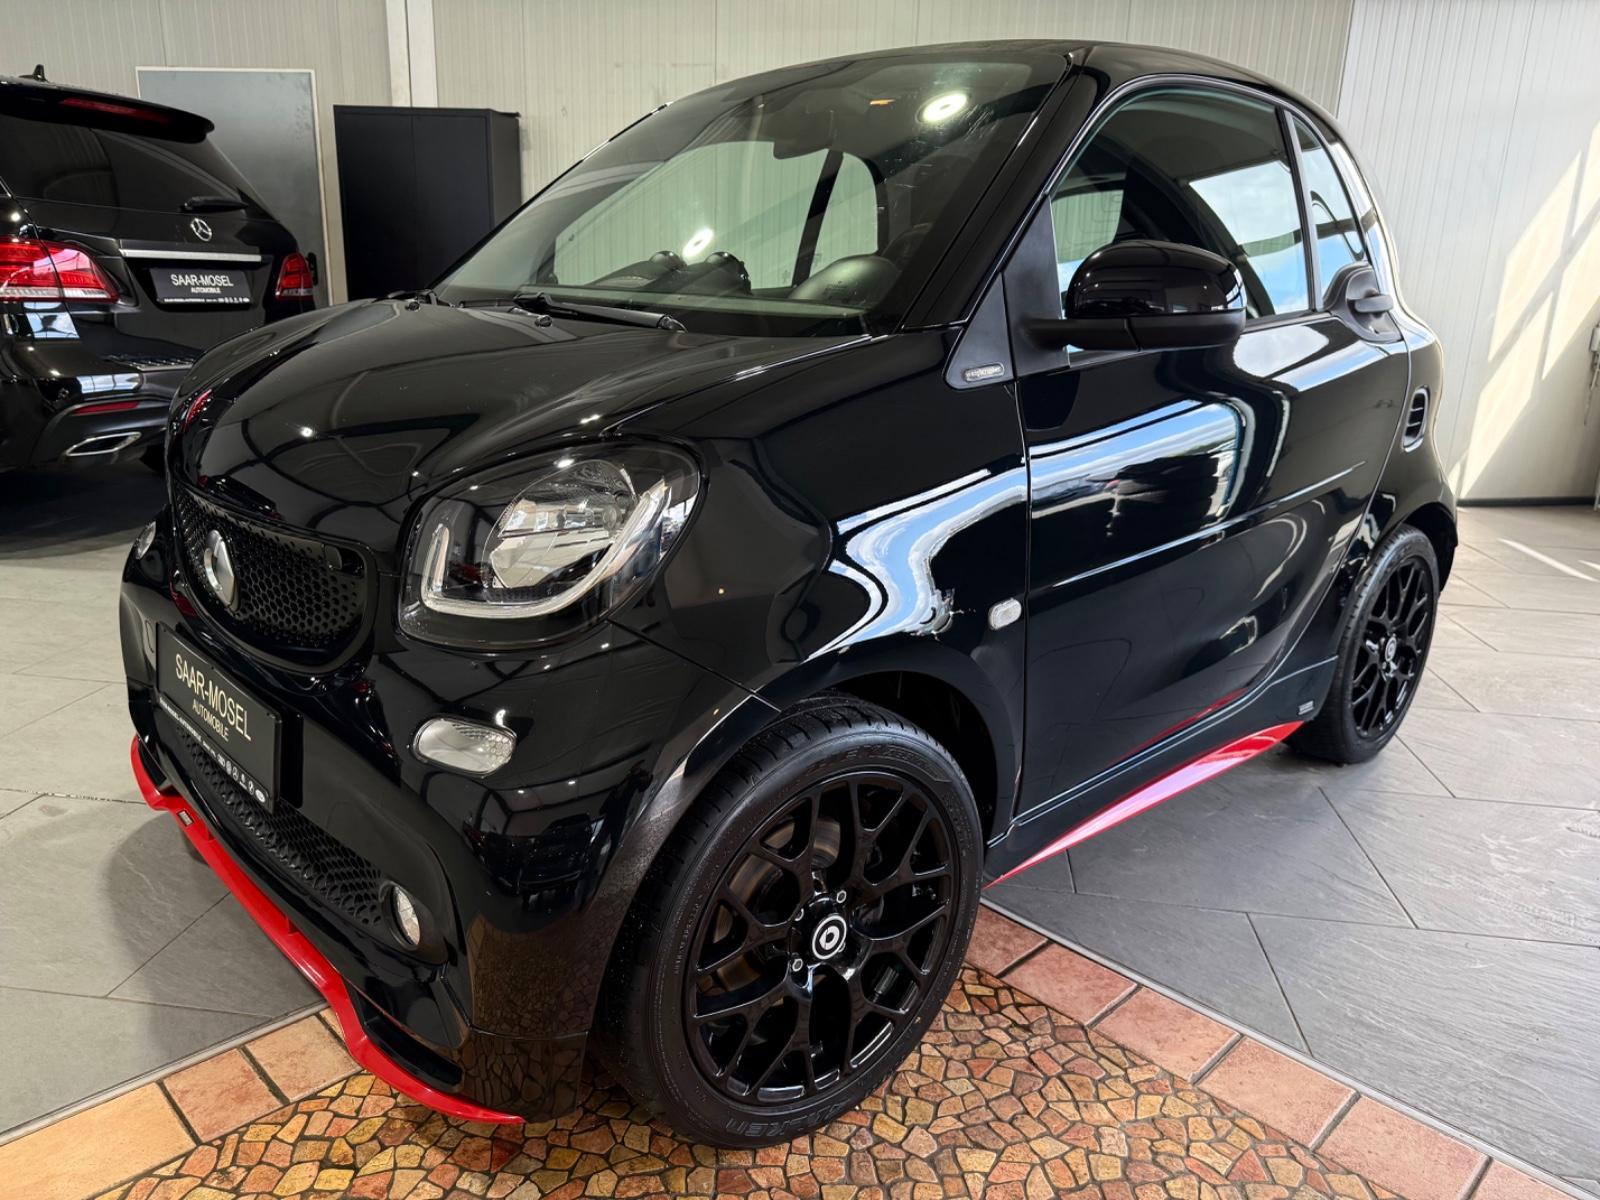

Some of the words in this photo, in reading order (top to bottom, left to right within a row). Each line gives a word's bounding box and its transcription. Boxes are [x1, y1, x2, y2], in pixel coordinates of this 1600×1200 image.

[170, 274, 234, 287] SAAR-MOSEL
[175, 653, 252, 741] SAAR-MOSEL
[192, 699, 229, 742] AUTOMOBILE
